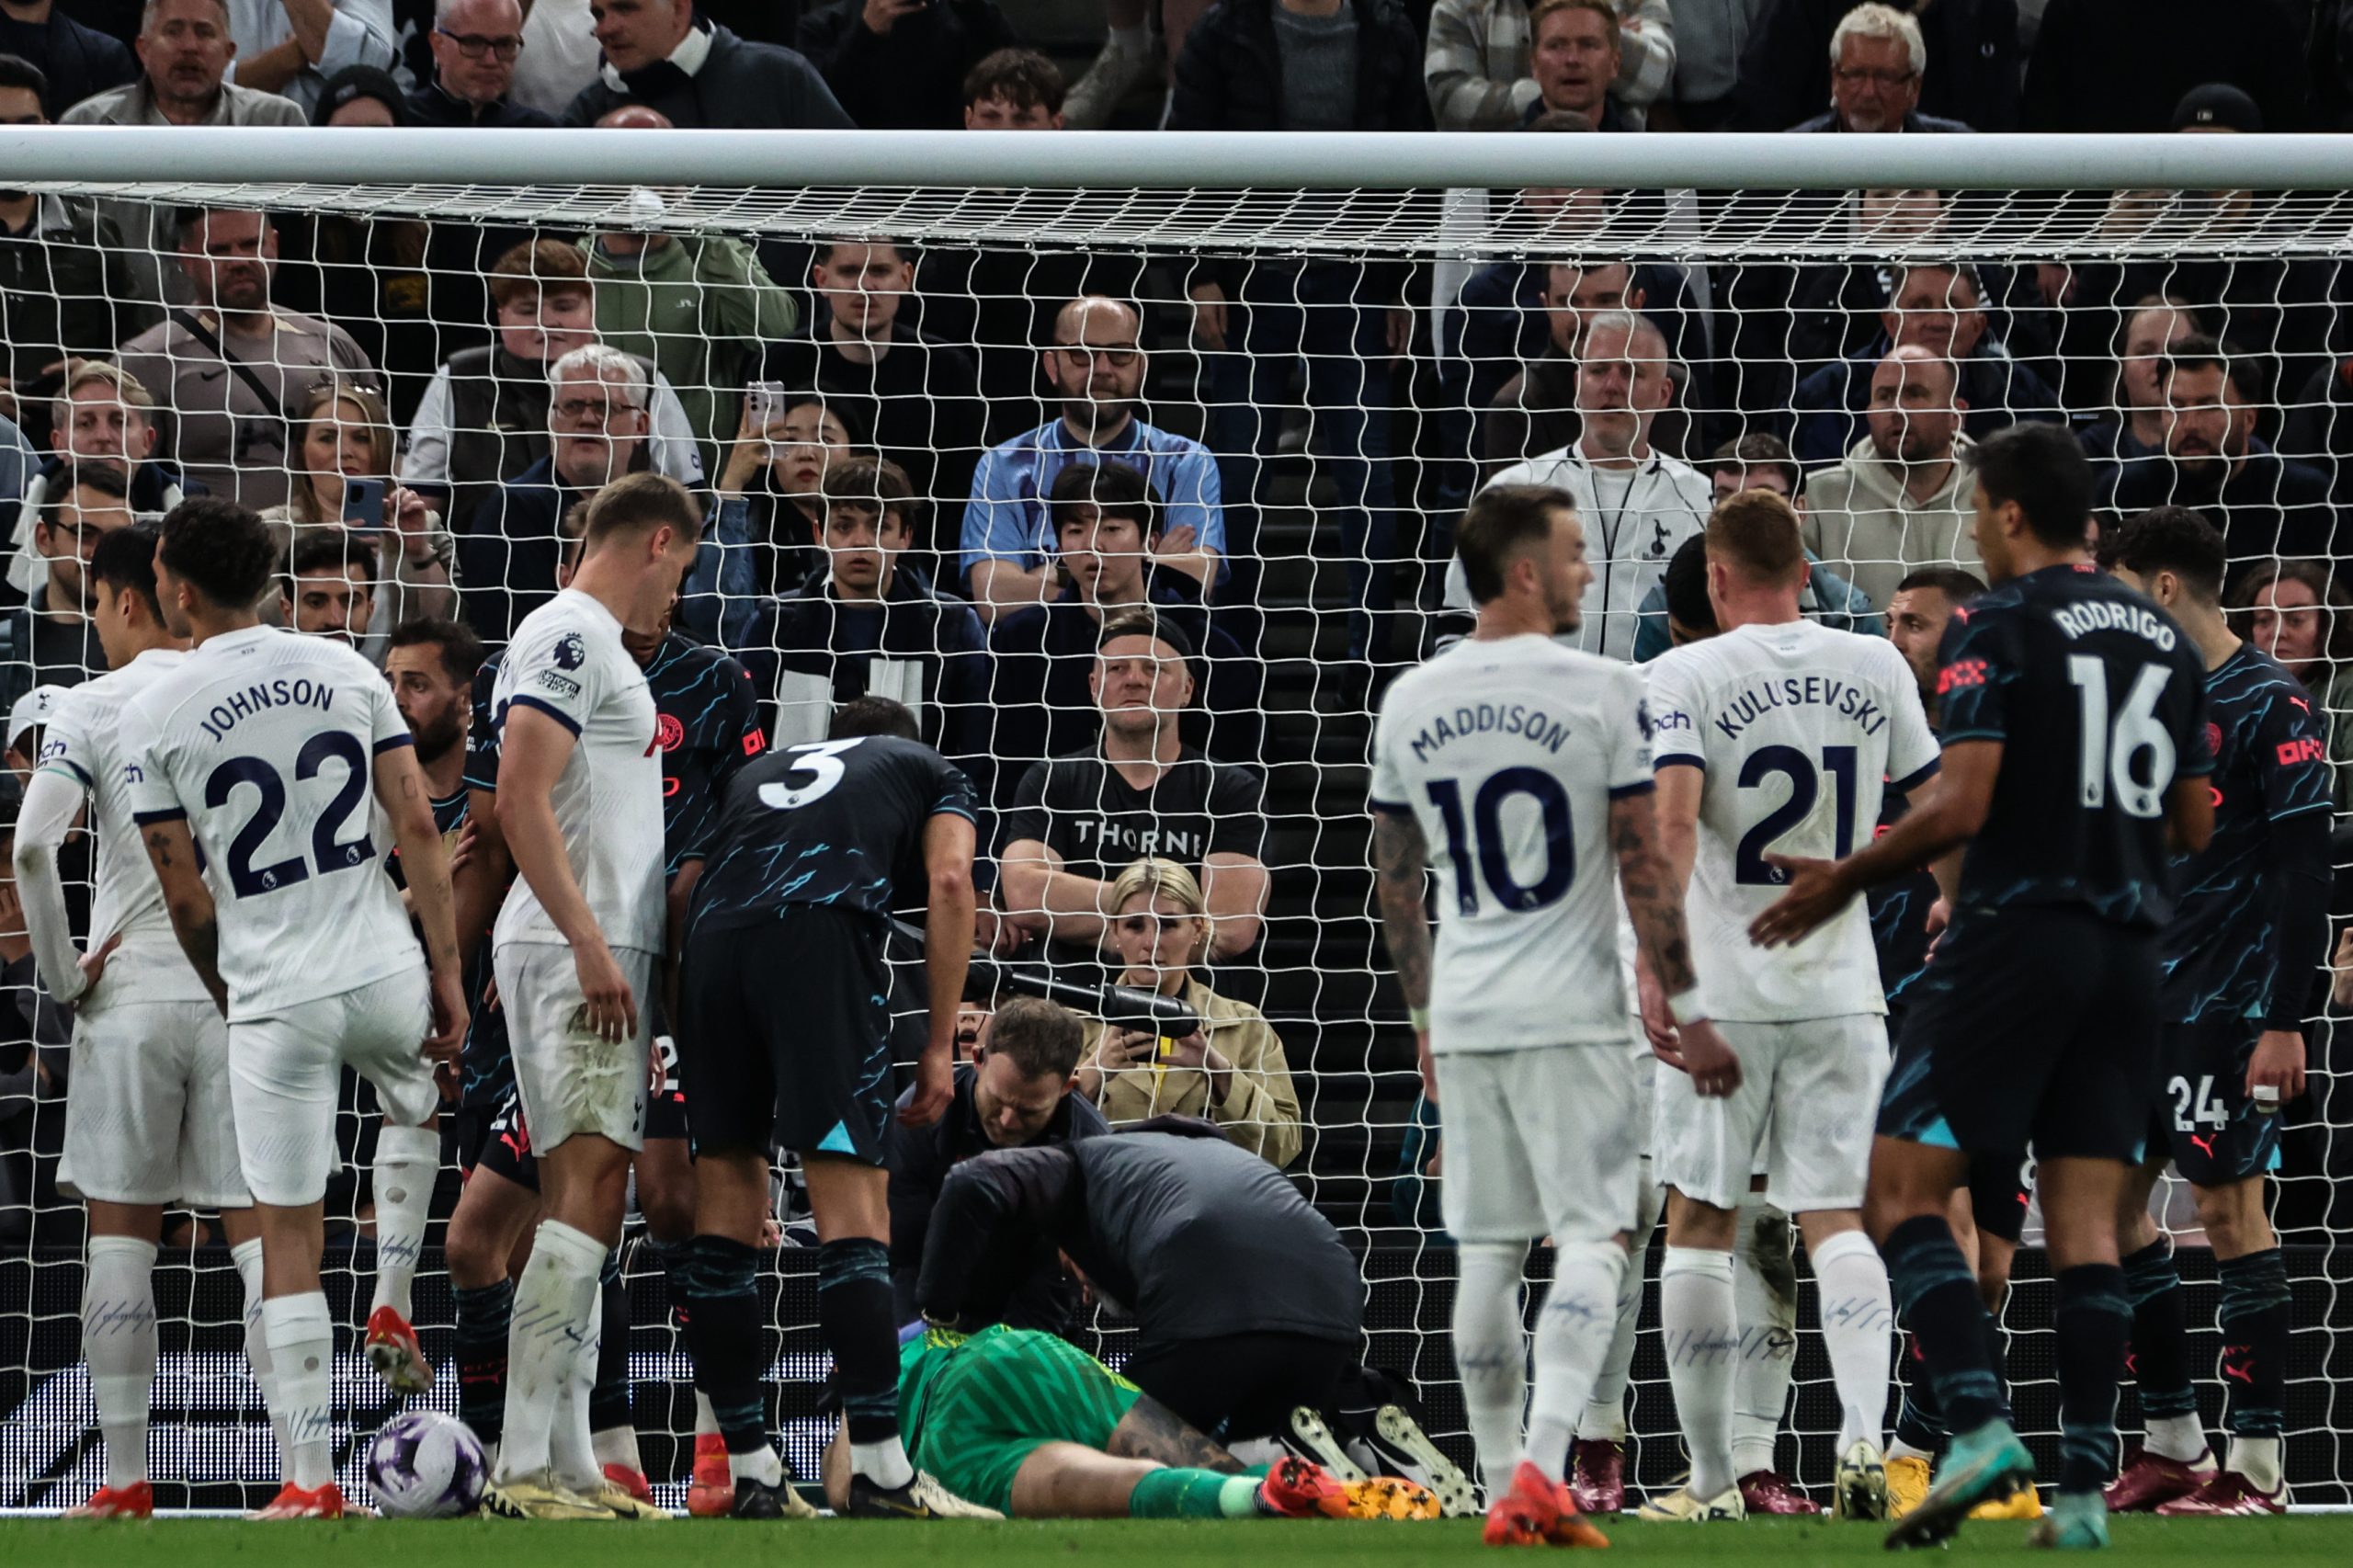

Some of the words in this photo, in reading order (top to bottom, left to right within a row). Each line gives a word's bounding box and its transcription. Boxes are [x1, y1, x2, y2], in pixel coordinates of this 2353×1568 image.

[2052, 601, 2177, 652] RODRIGO
[200, 678, 334, 743] JOHNSON
[1410, 704, 1571, 764] MADDISON
[1715, 676, 1887, 741] KULUSEVSKI
[2067, 654, 2177, 818] 16
[758, 735, 868, 810] 3
[205, 730, 377, 900] 22
[1426, 765, 1577, 918] 10
[1736, 744, 1859, 885] 21
[2166, 1074, 2230, 1131] 24
